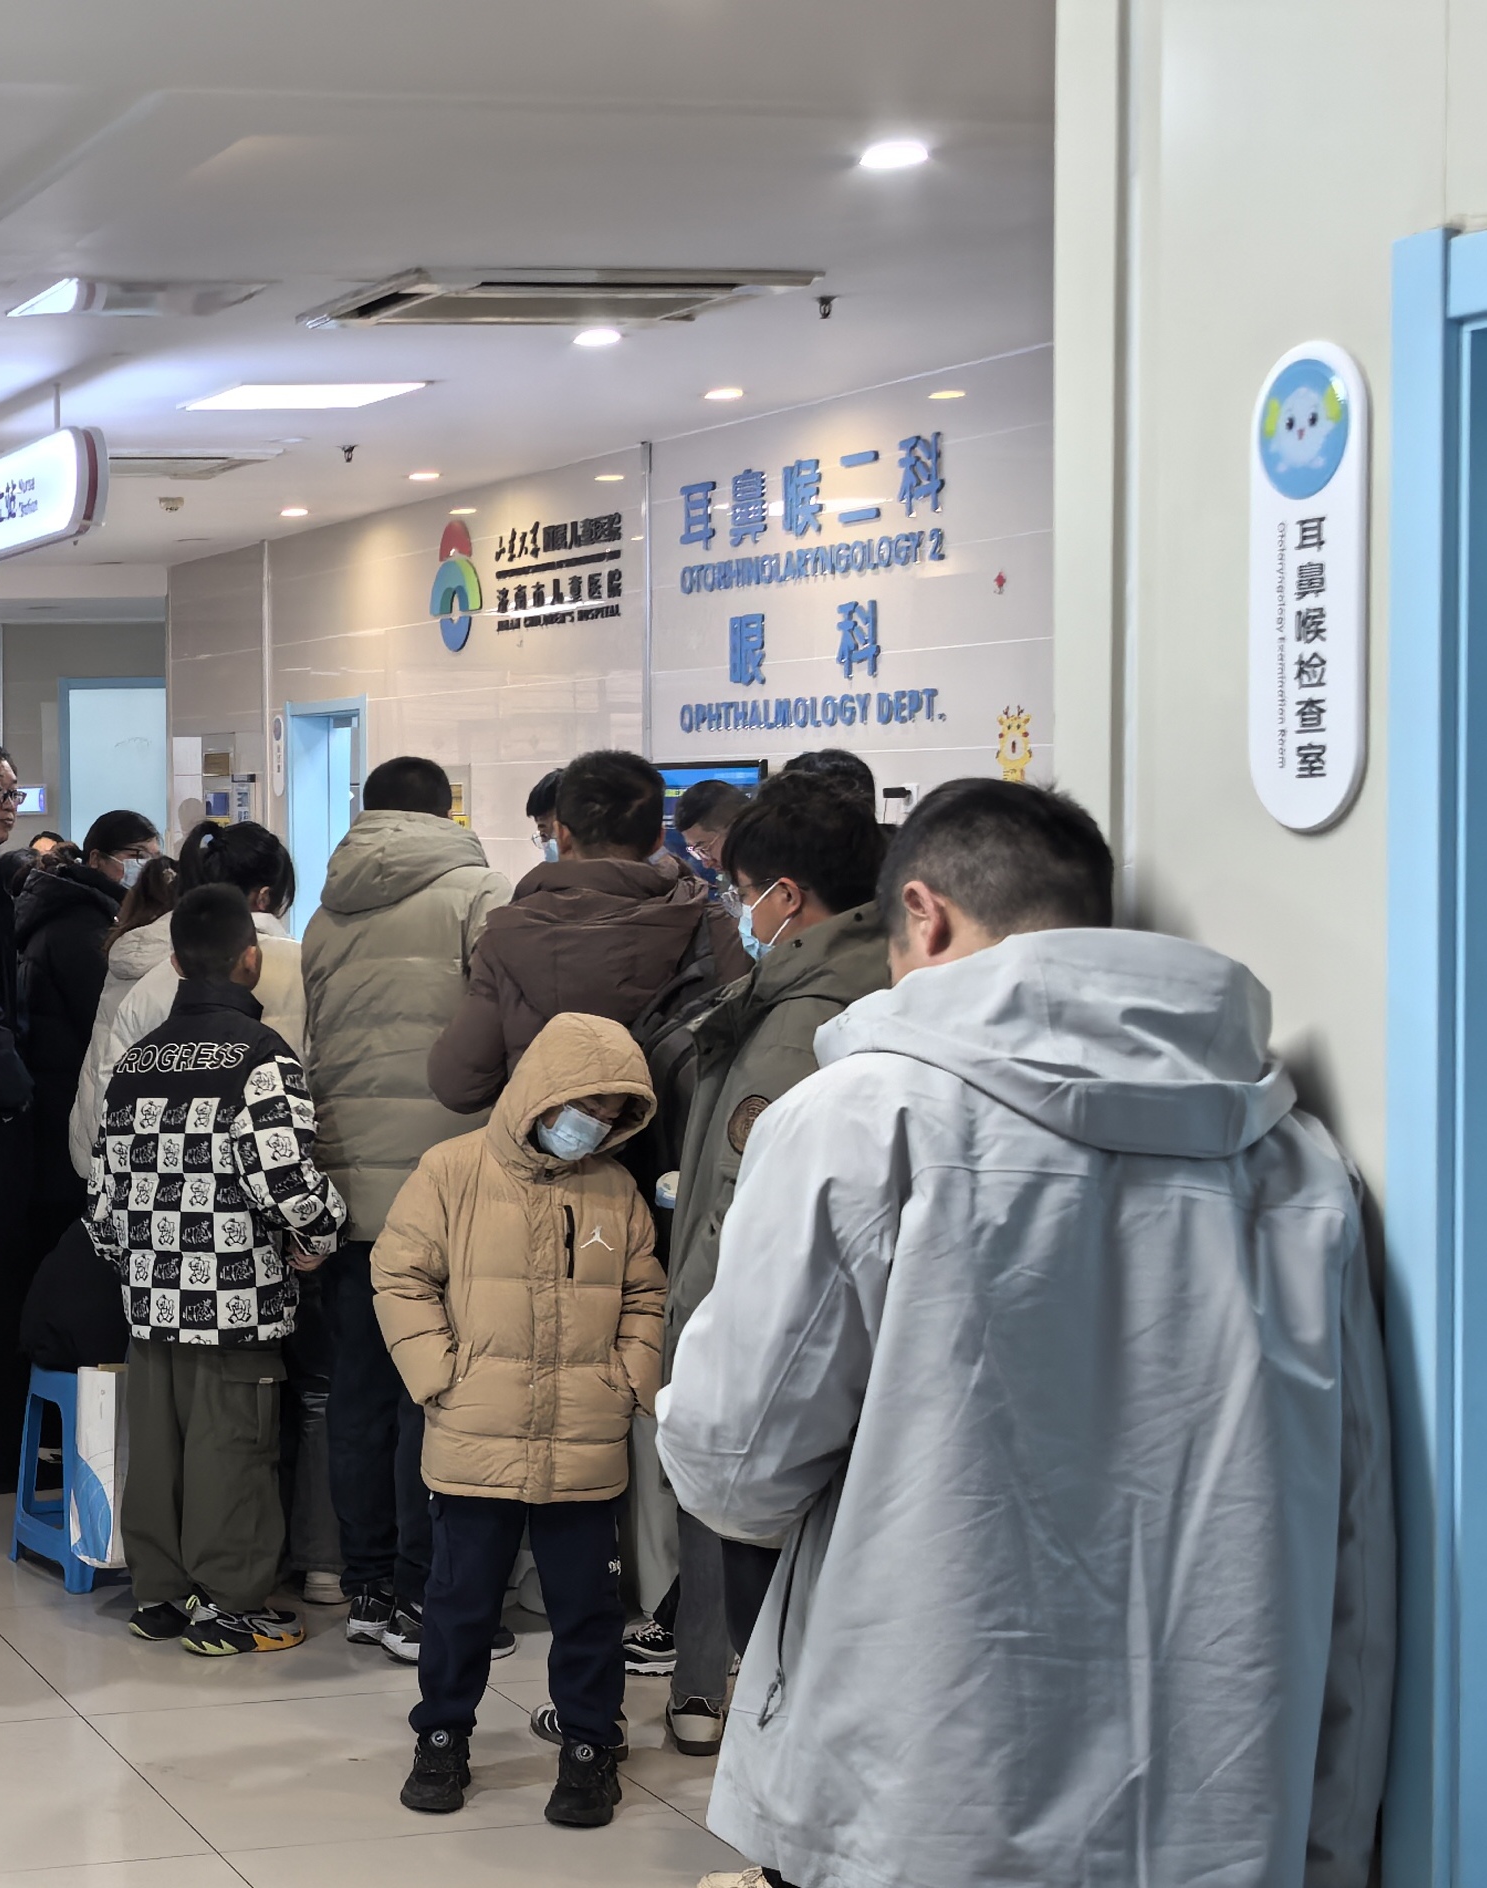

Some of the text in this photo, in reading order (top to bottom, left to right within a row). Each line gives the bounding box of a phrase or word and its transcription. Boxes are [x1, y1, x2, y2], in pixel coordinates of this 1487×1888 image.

[679, 431, 945, 550] 耳鼻喉二科
[929, 528, 945, 561] 2
[728, 600, 881, 686] 眼科
[1294, 516, 1327, 779] 耳鼻喉检查室
[680, 688, 947, 733] OPHTHALMOLOGY DEPT.
[116, 1041, 251, 1073] ROGRESS
